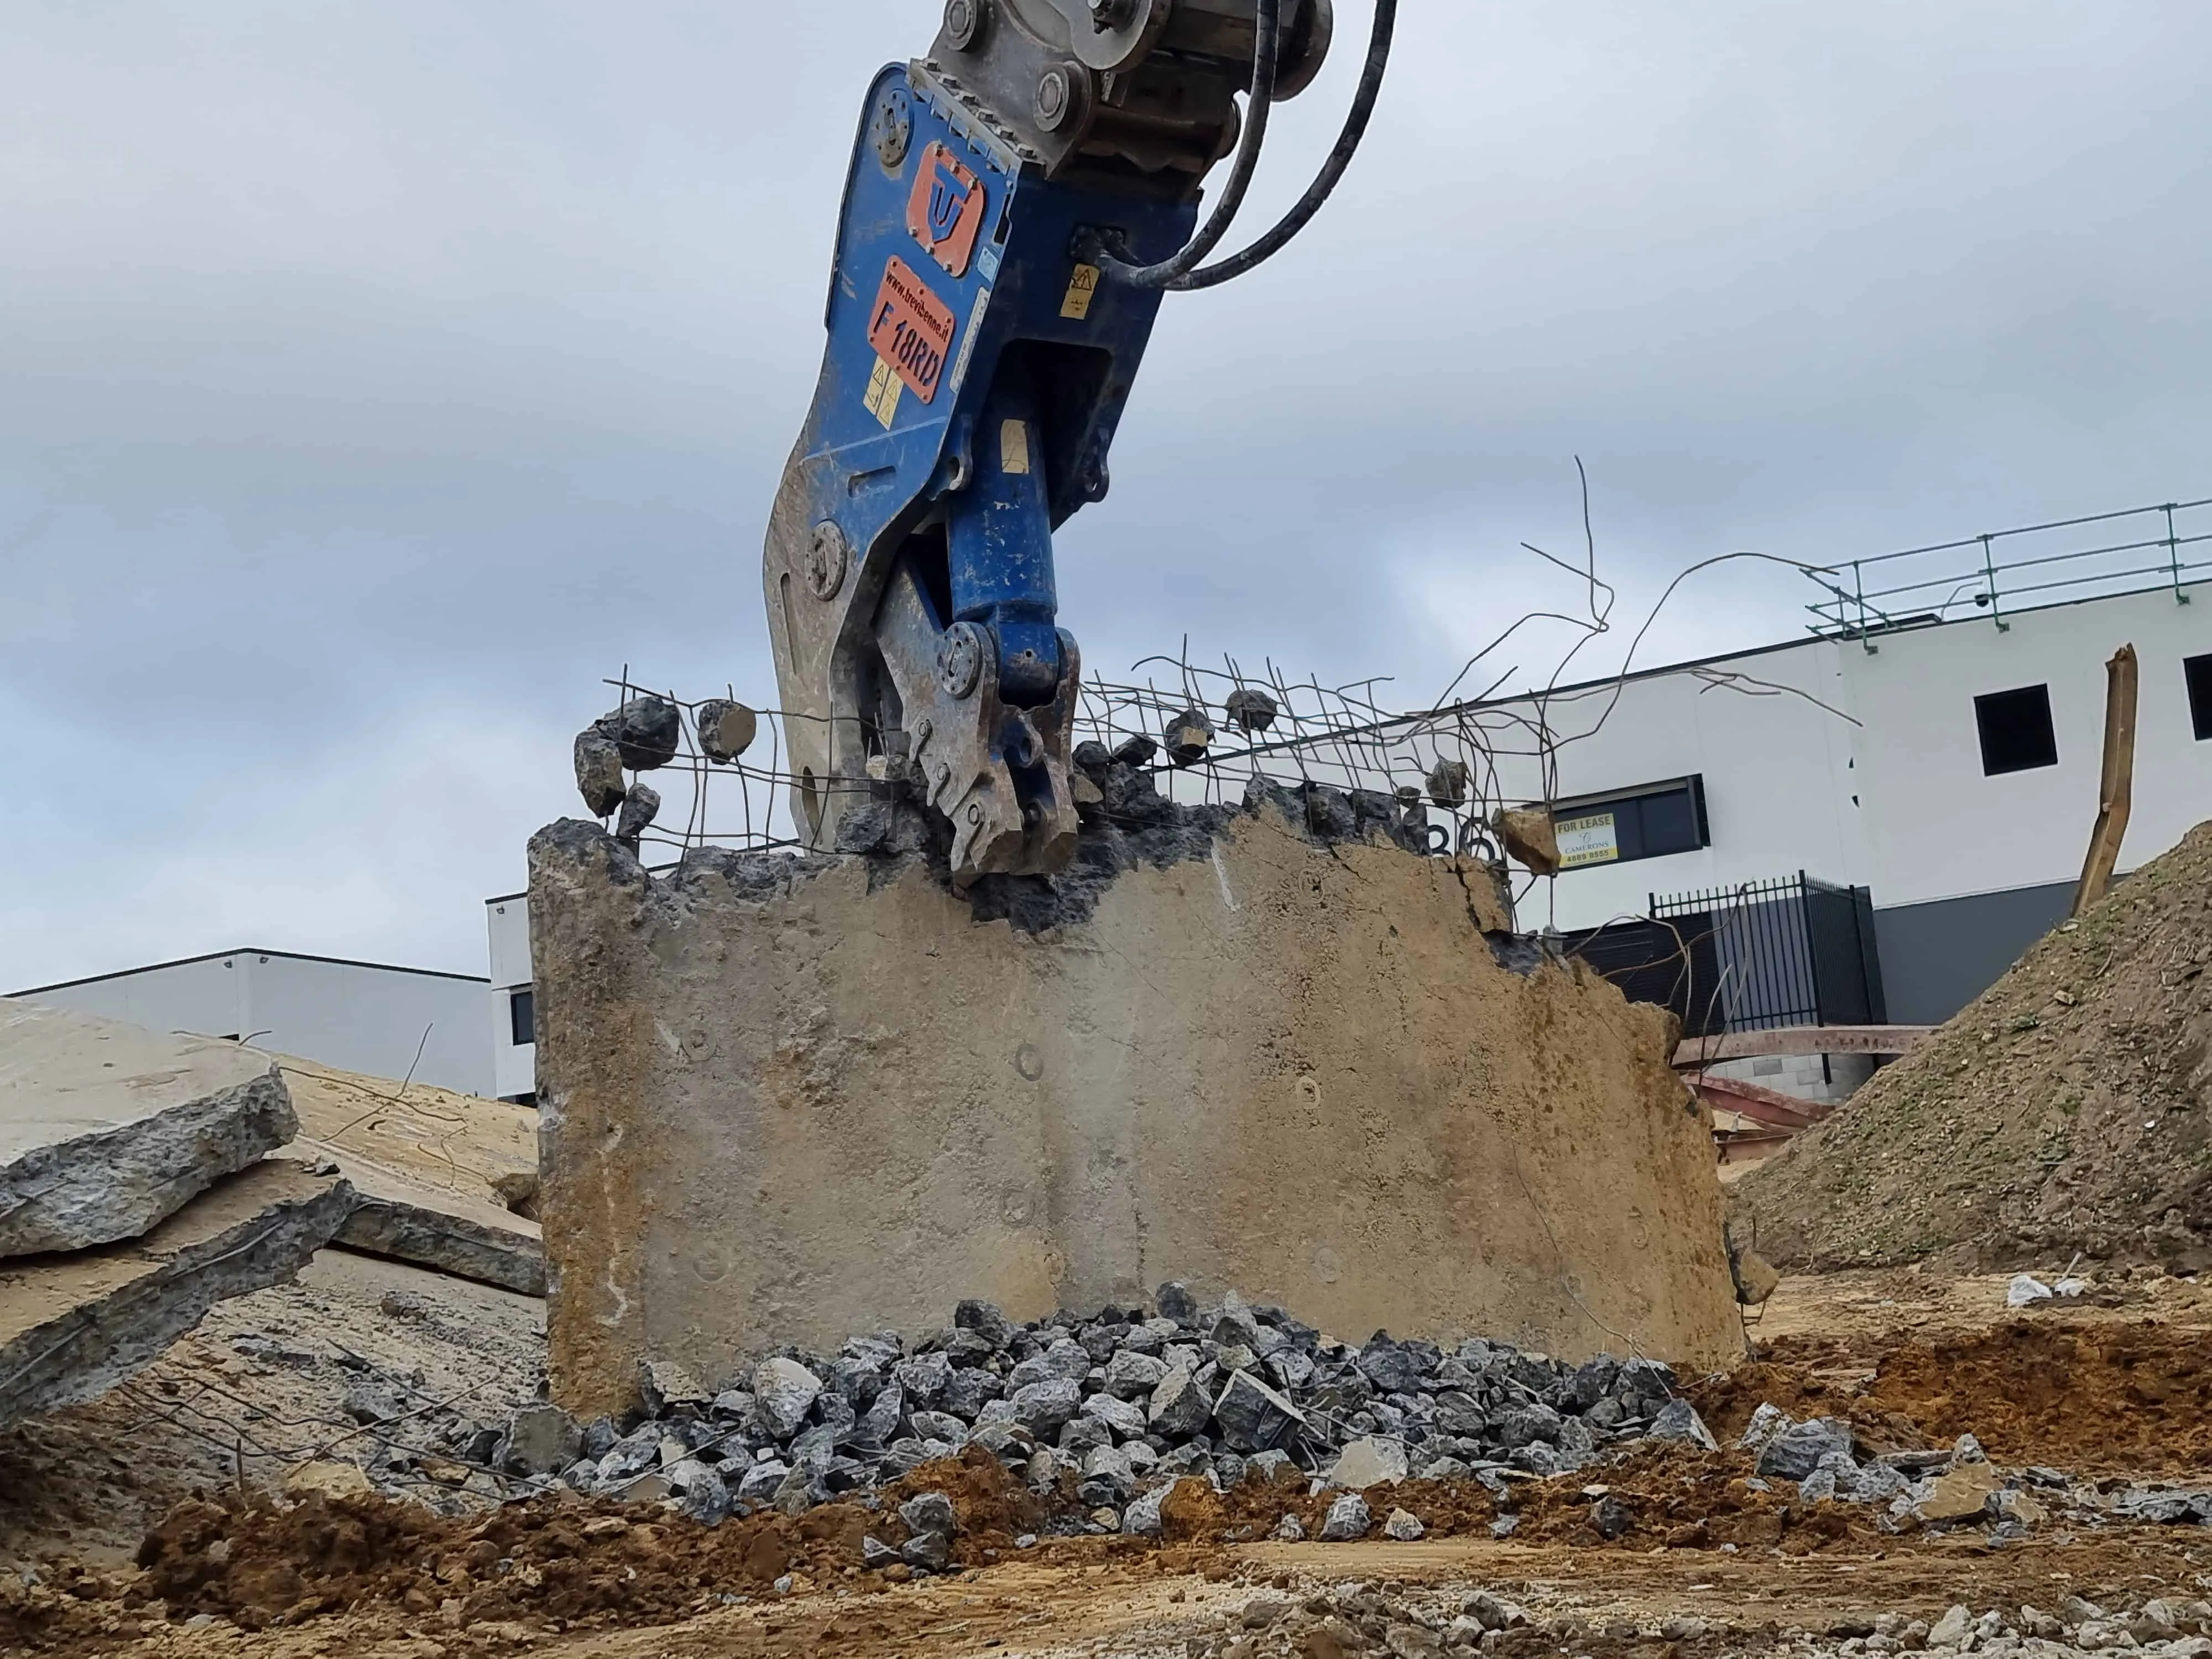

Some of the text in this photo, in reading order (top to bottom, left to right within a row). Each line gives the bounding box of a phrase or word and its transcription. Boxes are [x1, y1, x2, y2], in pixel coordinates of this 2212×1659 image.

[886, 270, 950, 342] www.trevibenne.it
[873, 301, 940, 387] F 18RD
[1558, 816, 1611, 834] FOR LEASE
[1565, 841, 1610, 853] CAMERONS
